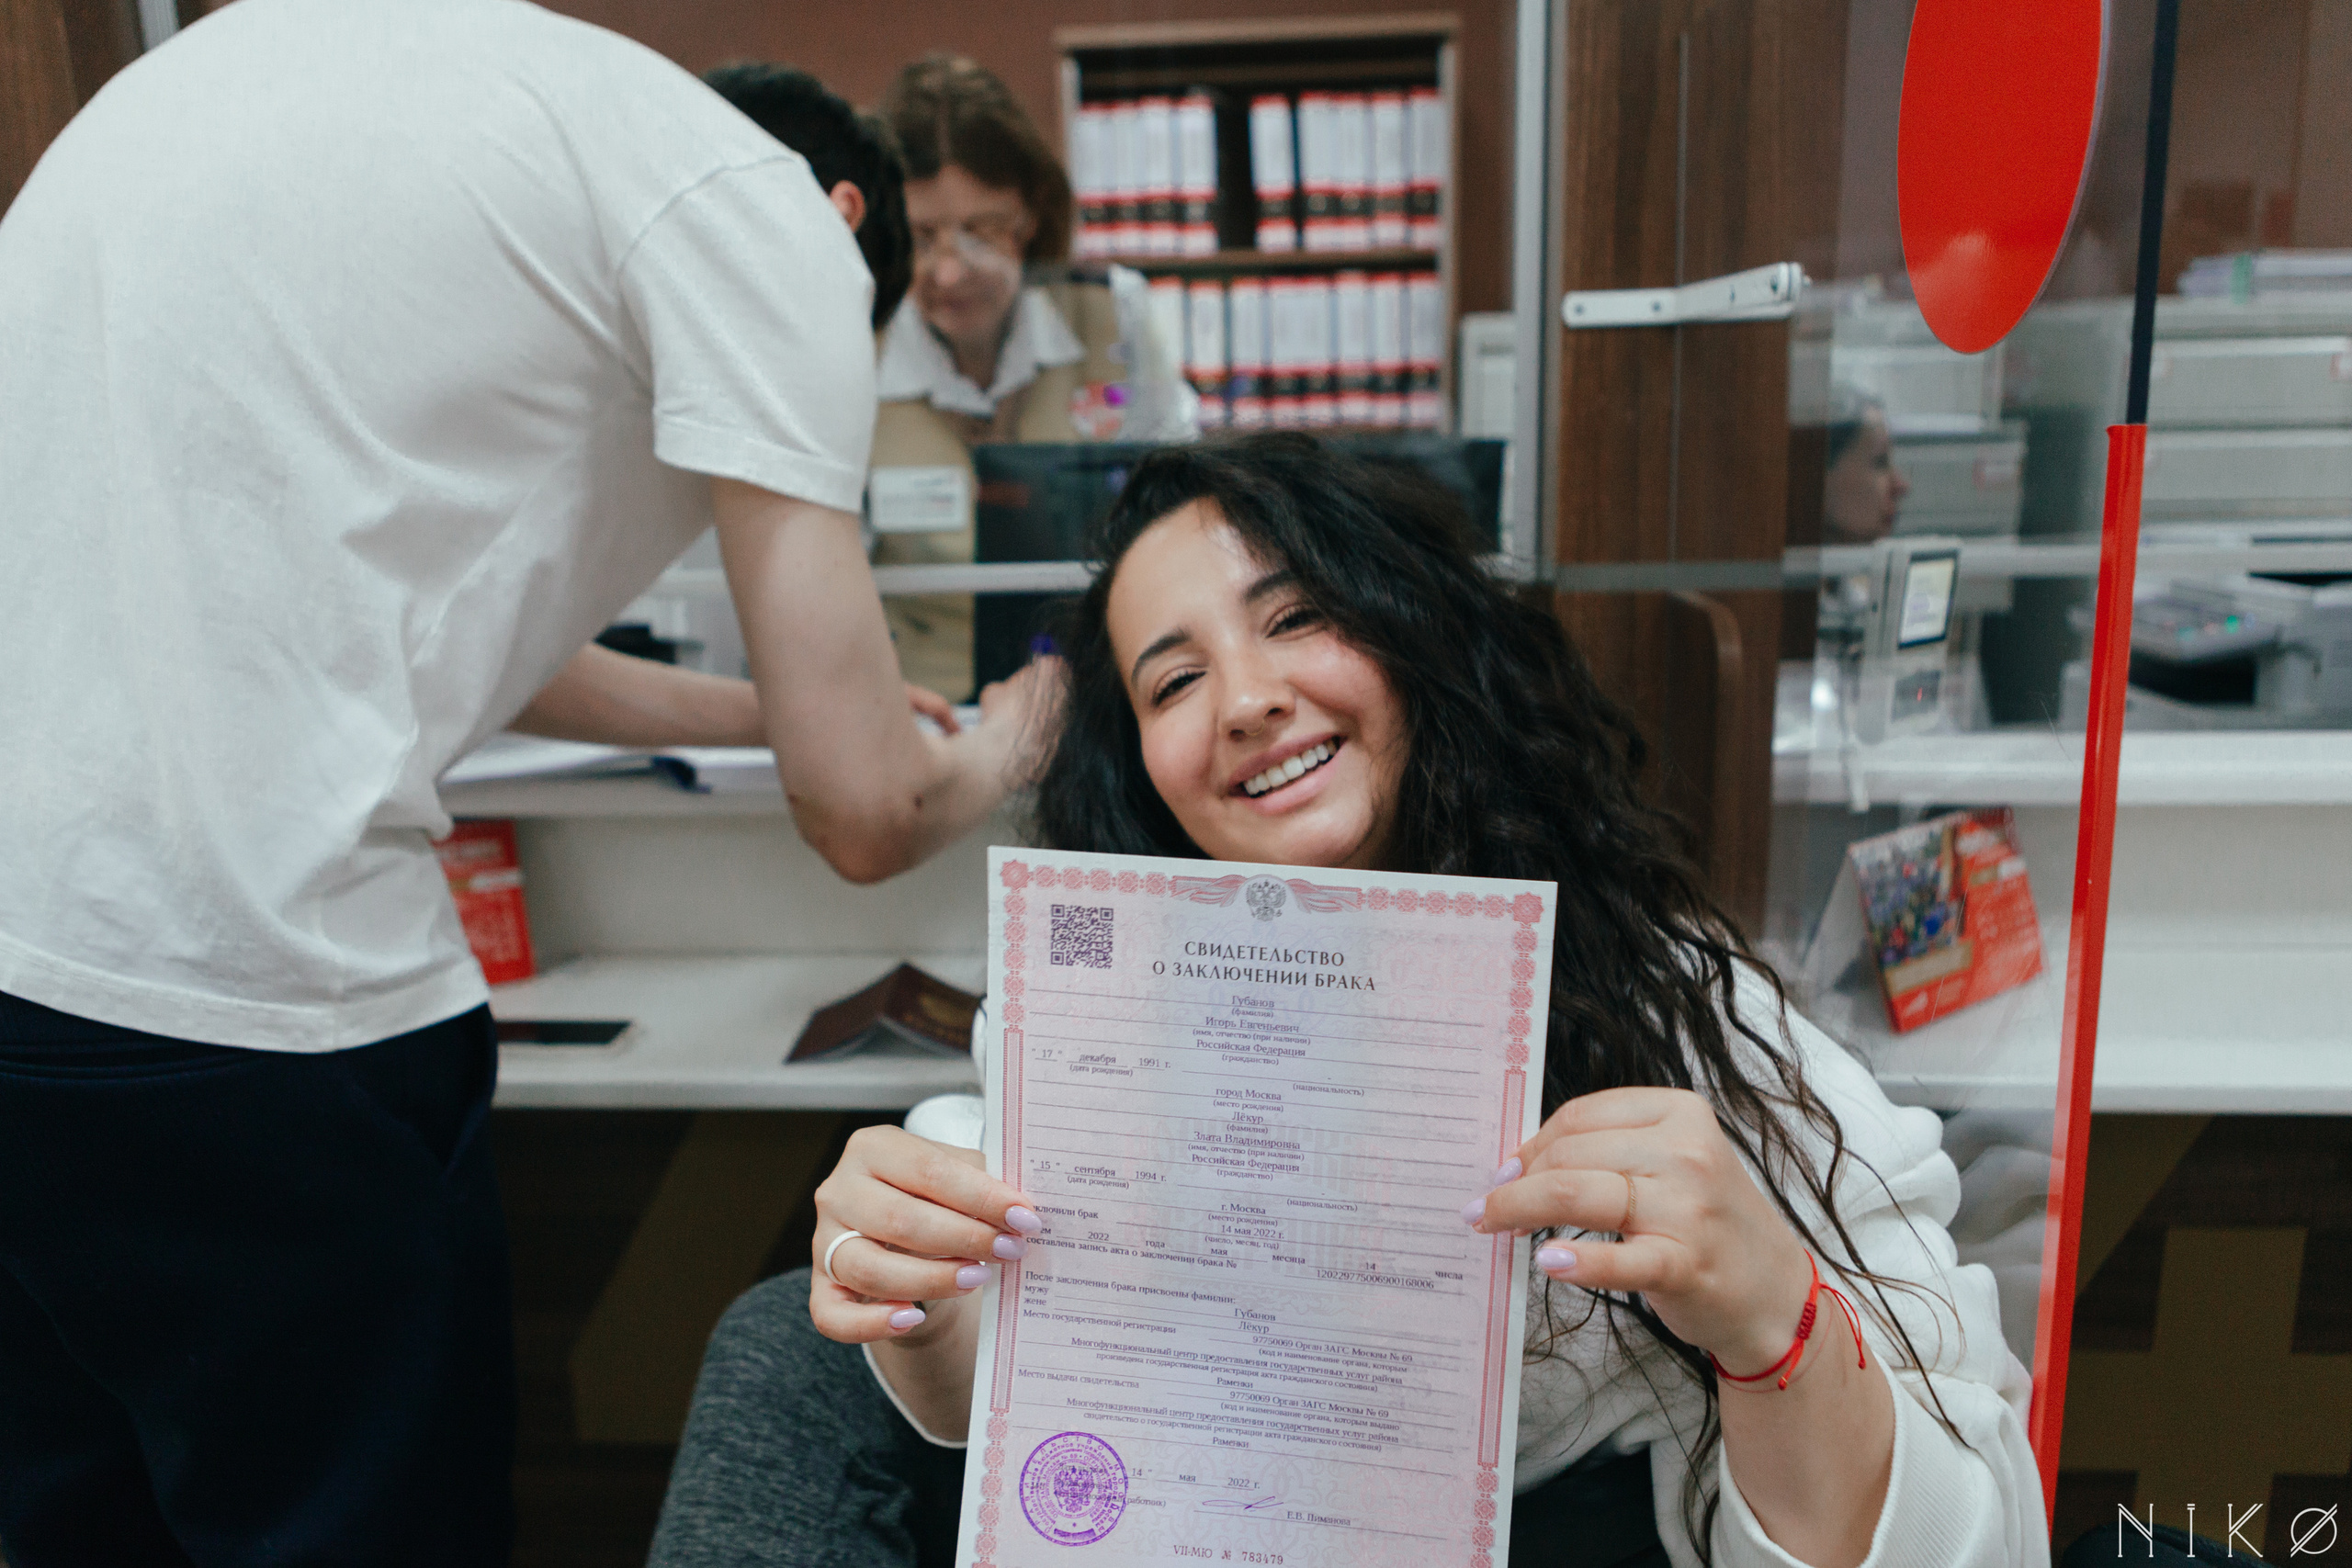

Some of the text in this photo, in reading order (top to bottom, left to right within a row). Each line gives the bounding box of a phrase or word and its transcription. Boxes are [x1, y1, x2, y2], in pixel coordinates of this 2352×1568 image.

[1184, 941, 1344, 966] СВИДЕТЕЛЬСТВО
[1152, 960, 1375, 991] О ЗАКЛЮЧЕНИИ БРАКА
[1232, 995, 1274, 1008] Губанов
[1231, 1008, 1273, 1019] (фамилия)
[1205, 1016, 1299, 1033] Игорь Евгеньевич
[1196, 1039, 1306, 1058] Российская Федерация
[1042, 1049, 1170, 1068] 17 декабря 1991 г.
[1222, 1054, 1279, 1066] (гражданство)
[1069, 1065, 1134, 1077] (дата рождения)
[1216, 1088, 1282, 1100] город Москва
[1293, 1083, 1364, 1097] (национальность)
[1213, 1099, 1283, 1112] (место рождения)
[1231, 1111, 1264, 1124] Лёкур
[1226, 1122, 1268, 1134] (фамилия)
[1193, 1132, 1300, 1149] Злата Владимировна
[1040, 1160, 1167, 1182] 15 сентября 1994 г.
[1192, 1153, 1300, 1173] Российская Федерация
[1067, 1175, 1129, 1190] (дата рождения)
[1216, 1168, 1273, 1181] (гражданство)
[1034, 1205, 1099, 1219] ключили брак
[1230, 1203, 1266, 1215] Москва
[1286, 1198, 1358, 1213] (национальность)
[1208, 1213, 1278, 1227] (место рождения)
[1221, 1224, 1284, 1240] 14 мая 2022 г.
[1026, 1236, 1075, 1248] составлена
[1078, 1243, 1108, 1253] запись
[1110, 1247, 1129, 1256] акта
[1139, 1250, 1194, 1264] заключении
[1197, 1256, 1224, 1269] брака
[1226, 1259, 1237, 1269] №
[1088, 1231, 1109, 1241] 2022
[1146, 1240, 1165, 1249] года
[1210, 1248, 1227, 1257] мая
[1272, 1254, 1306, 1265] месяца
[1365, 1262, 1376, 1270] 14
[1435, 1269, 1463, 1280] числа
[1025, 1270, 1236, 1304] После заключения брака присвоены фамилии:
[1024, 1285, 1275, 1322] мужу Губанов
[1023, 1297, 1269, 1334] жене Лёкур
[1023, 1309, 1176, 1334] Место государственной регистрации
[1252, 1335, 1413, 1362] 97750069 Орган ЗАГС Москвы № 69
[1071, 1337, 1403, 1385] Многофункциональный центр предоставления государственных услуг района
[1018, 1369, 1139, 1389] Место выдачи свидетельства
[1216, 1377, 1253, 1389] Раменки
[1229, 1391, 1389, 1418] 97750069 Орган ЗАГС Москвы № 69
[1067, 1397, 1399, 1444] Многофункциональный центр предоставления государственных услуг района
[1212, 1437, 1250, 1449] Раменки
[1132, 1468, 1261, 1489] 14 мая 2022 г.
[1173, 1544, 1283, 1565] VII-МЮ № 783479
